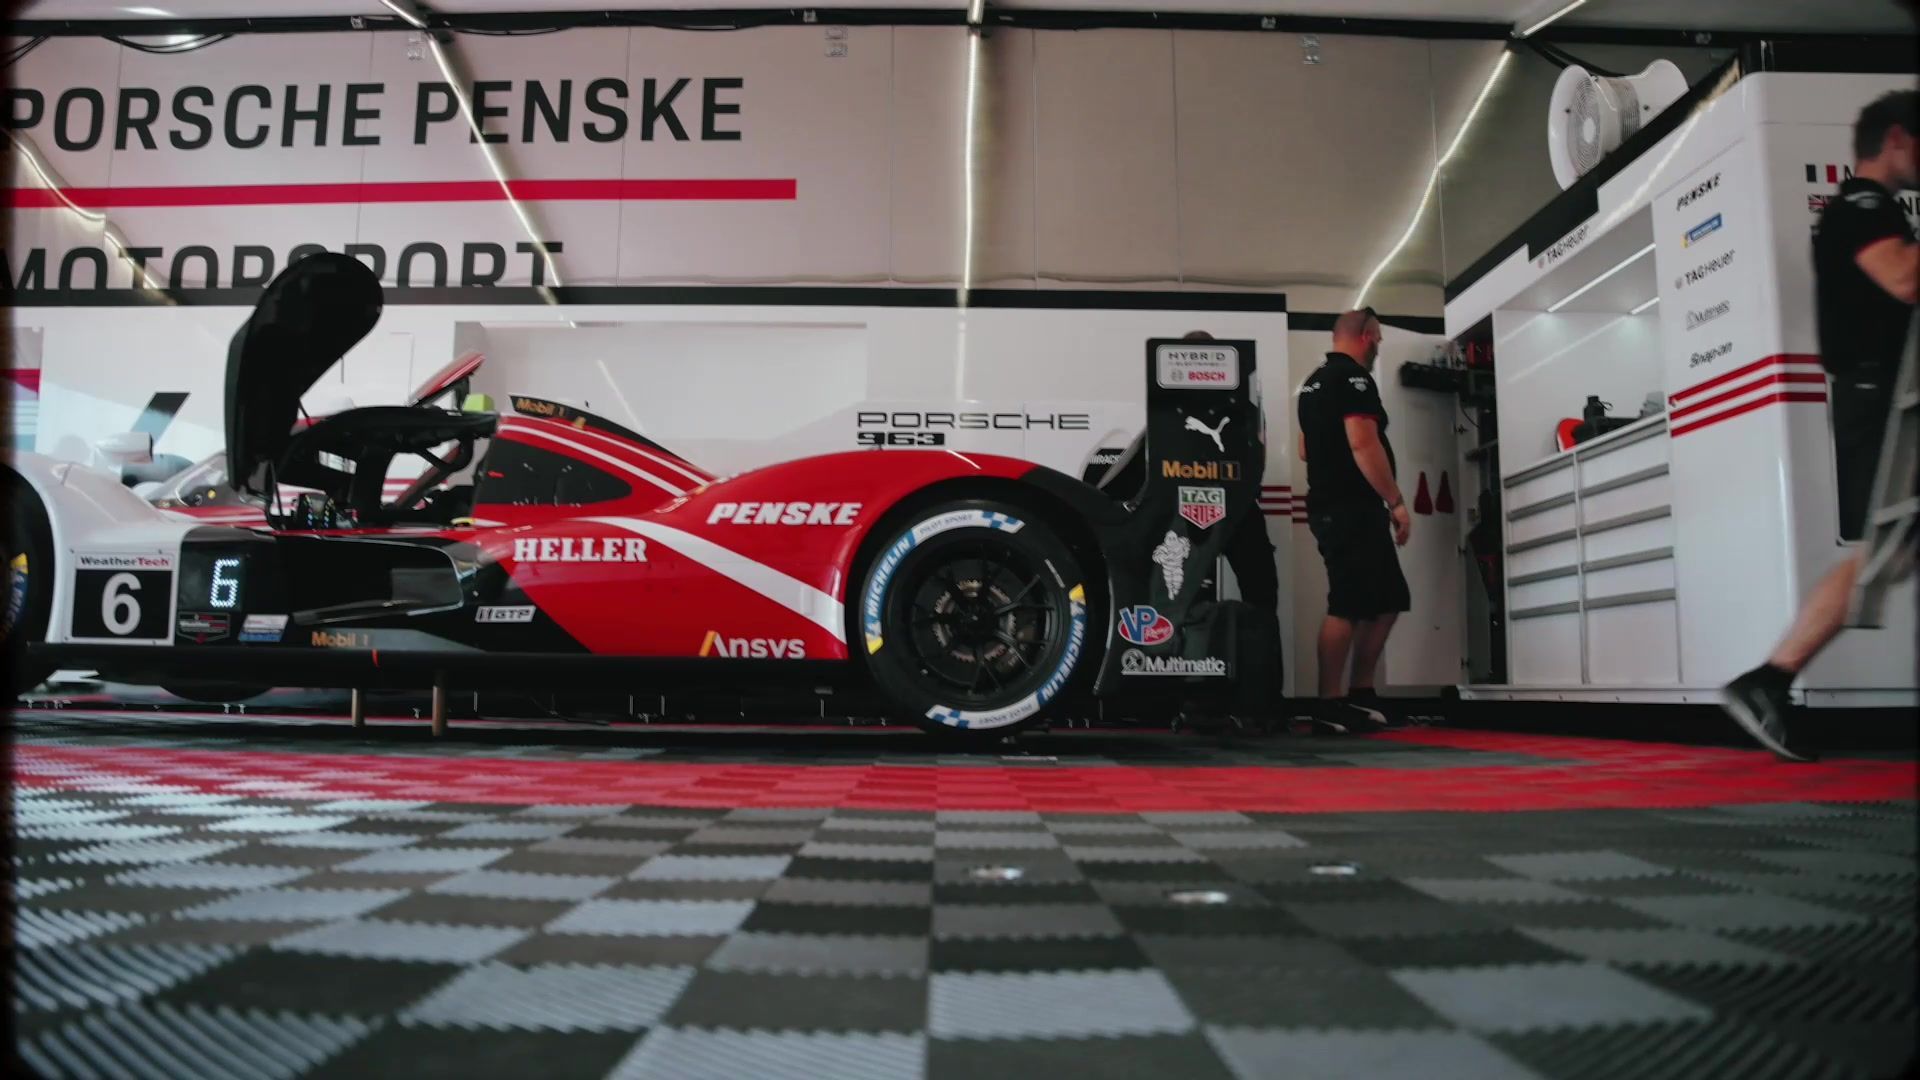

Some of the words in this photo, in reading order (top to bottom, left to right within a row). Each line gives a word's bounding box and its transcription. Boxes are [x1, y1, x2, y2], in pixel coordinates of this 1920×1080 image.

[4, 82, 384, 152] PORSCHE
[413, 77, 744, 146] PENSKE
[1676, 172, 1721, 211] PENSKE
[1187, 370, 1226, 381] BOSCH
[856, 412, 1090, 430] PORSCHE
[856, 432, 945, 446] 963
[1161, 460, 1218, 479] Mobil
[1183, 490, 1222, 503] TAG
[706, 502, 863, 526] PENSKE
[1182, 504, 1225, 521] HEUER
[80, 556, 170, 567] WeatherTech
[512, 537, 648, 563] HELLER
[209, 558, 240, 608] 6
[866, 538, 911, 619] MICHELIN
[101, 571, 143, 636] 6
[1119, 605, 1158, 643] VP
[311, 631, 357, 648] Mobil
[699, 629, 806, 659] Ansys
[1040, 620, 1085, 701] MICHELIN
[1145, 655, 1226, 673] Multimatic
